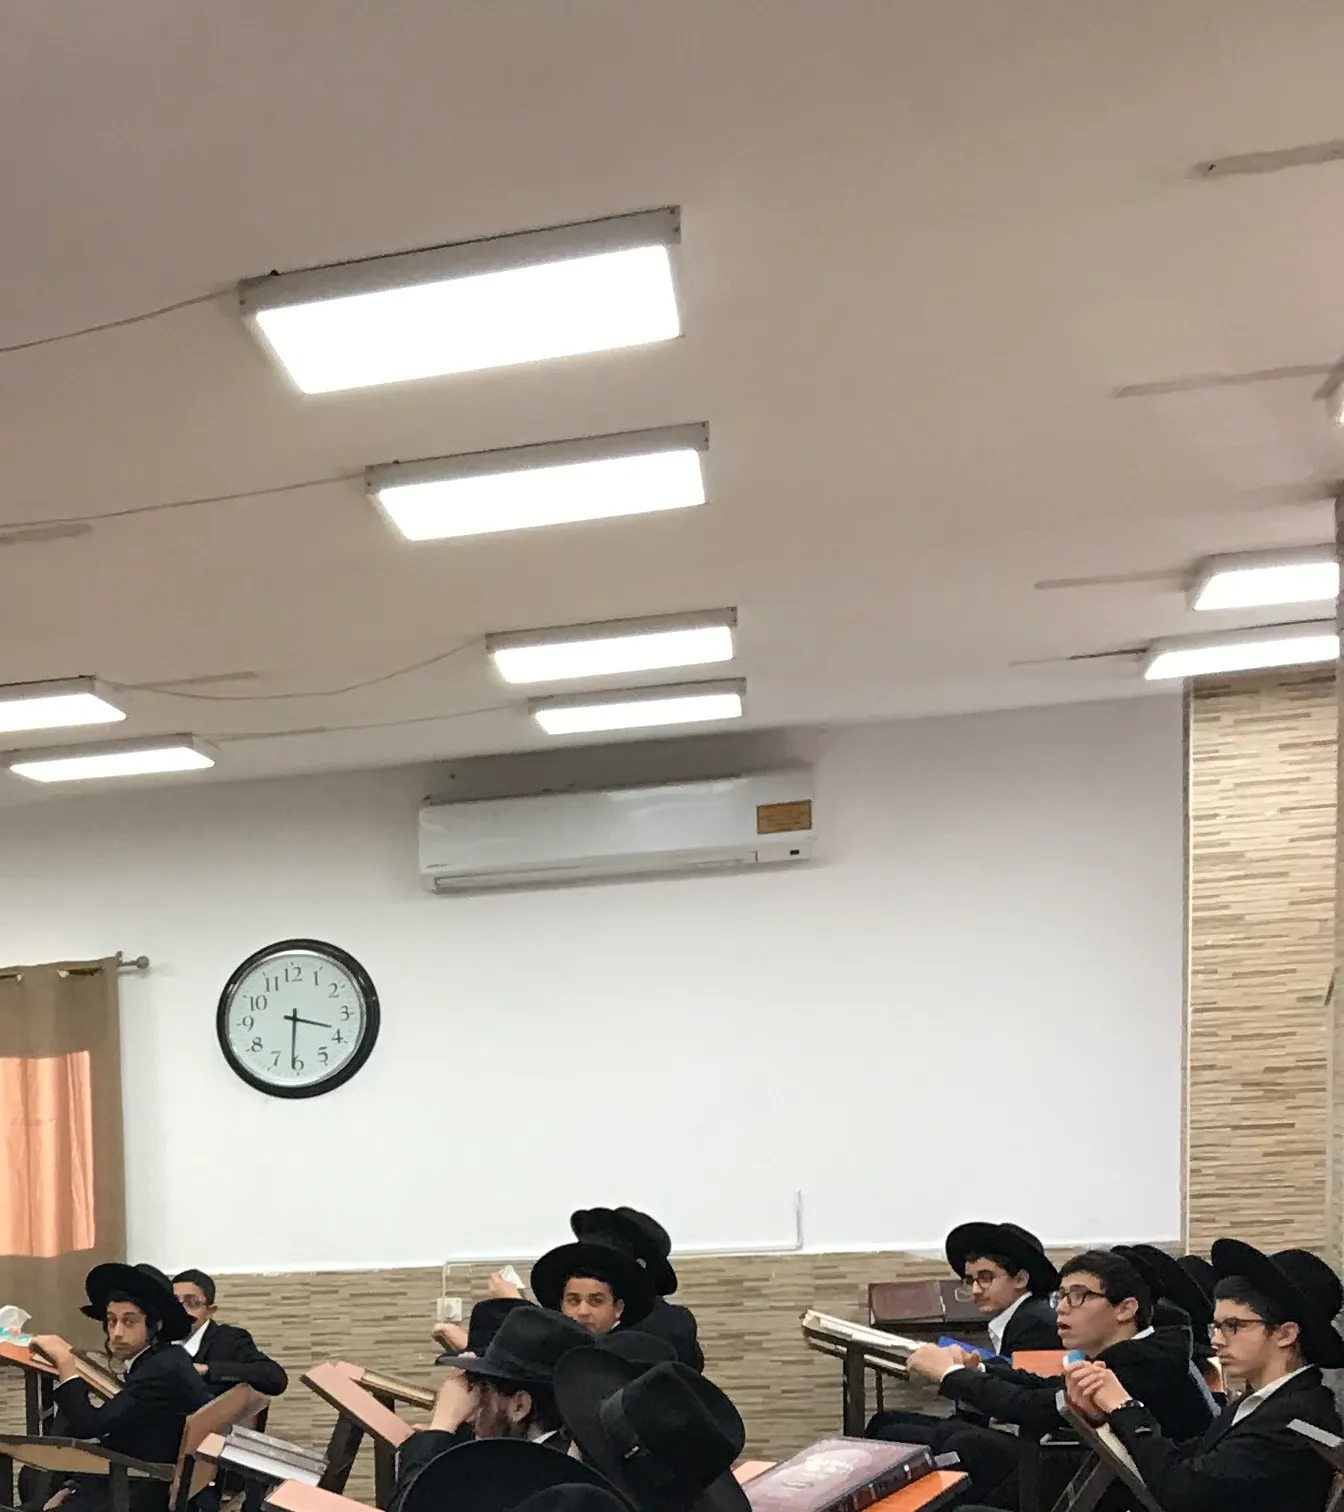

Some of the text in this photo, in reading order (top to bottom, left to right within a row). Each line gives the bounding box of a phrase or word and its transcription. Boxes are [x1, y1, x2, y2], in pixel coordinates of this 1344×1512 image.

[283, 965, 303, 983] 12
[313, 970, 320, 986] 1
[264, 975, 280, 992] 11
[328, 982, 340, 999] 2
[248, 994, 268, 1011] 10
[339, 1005, 350, 1021] 3
[241, 1015, 254, 1032] 9
[250, 1036, 263, 1053] 8
[331, 1028, 343, 1044] 4
[270, 1050, 282, 1067] 7
[292, 1054, 305, 1072] 6
[317, 1046, 329, 1063] 5
